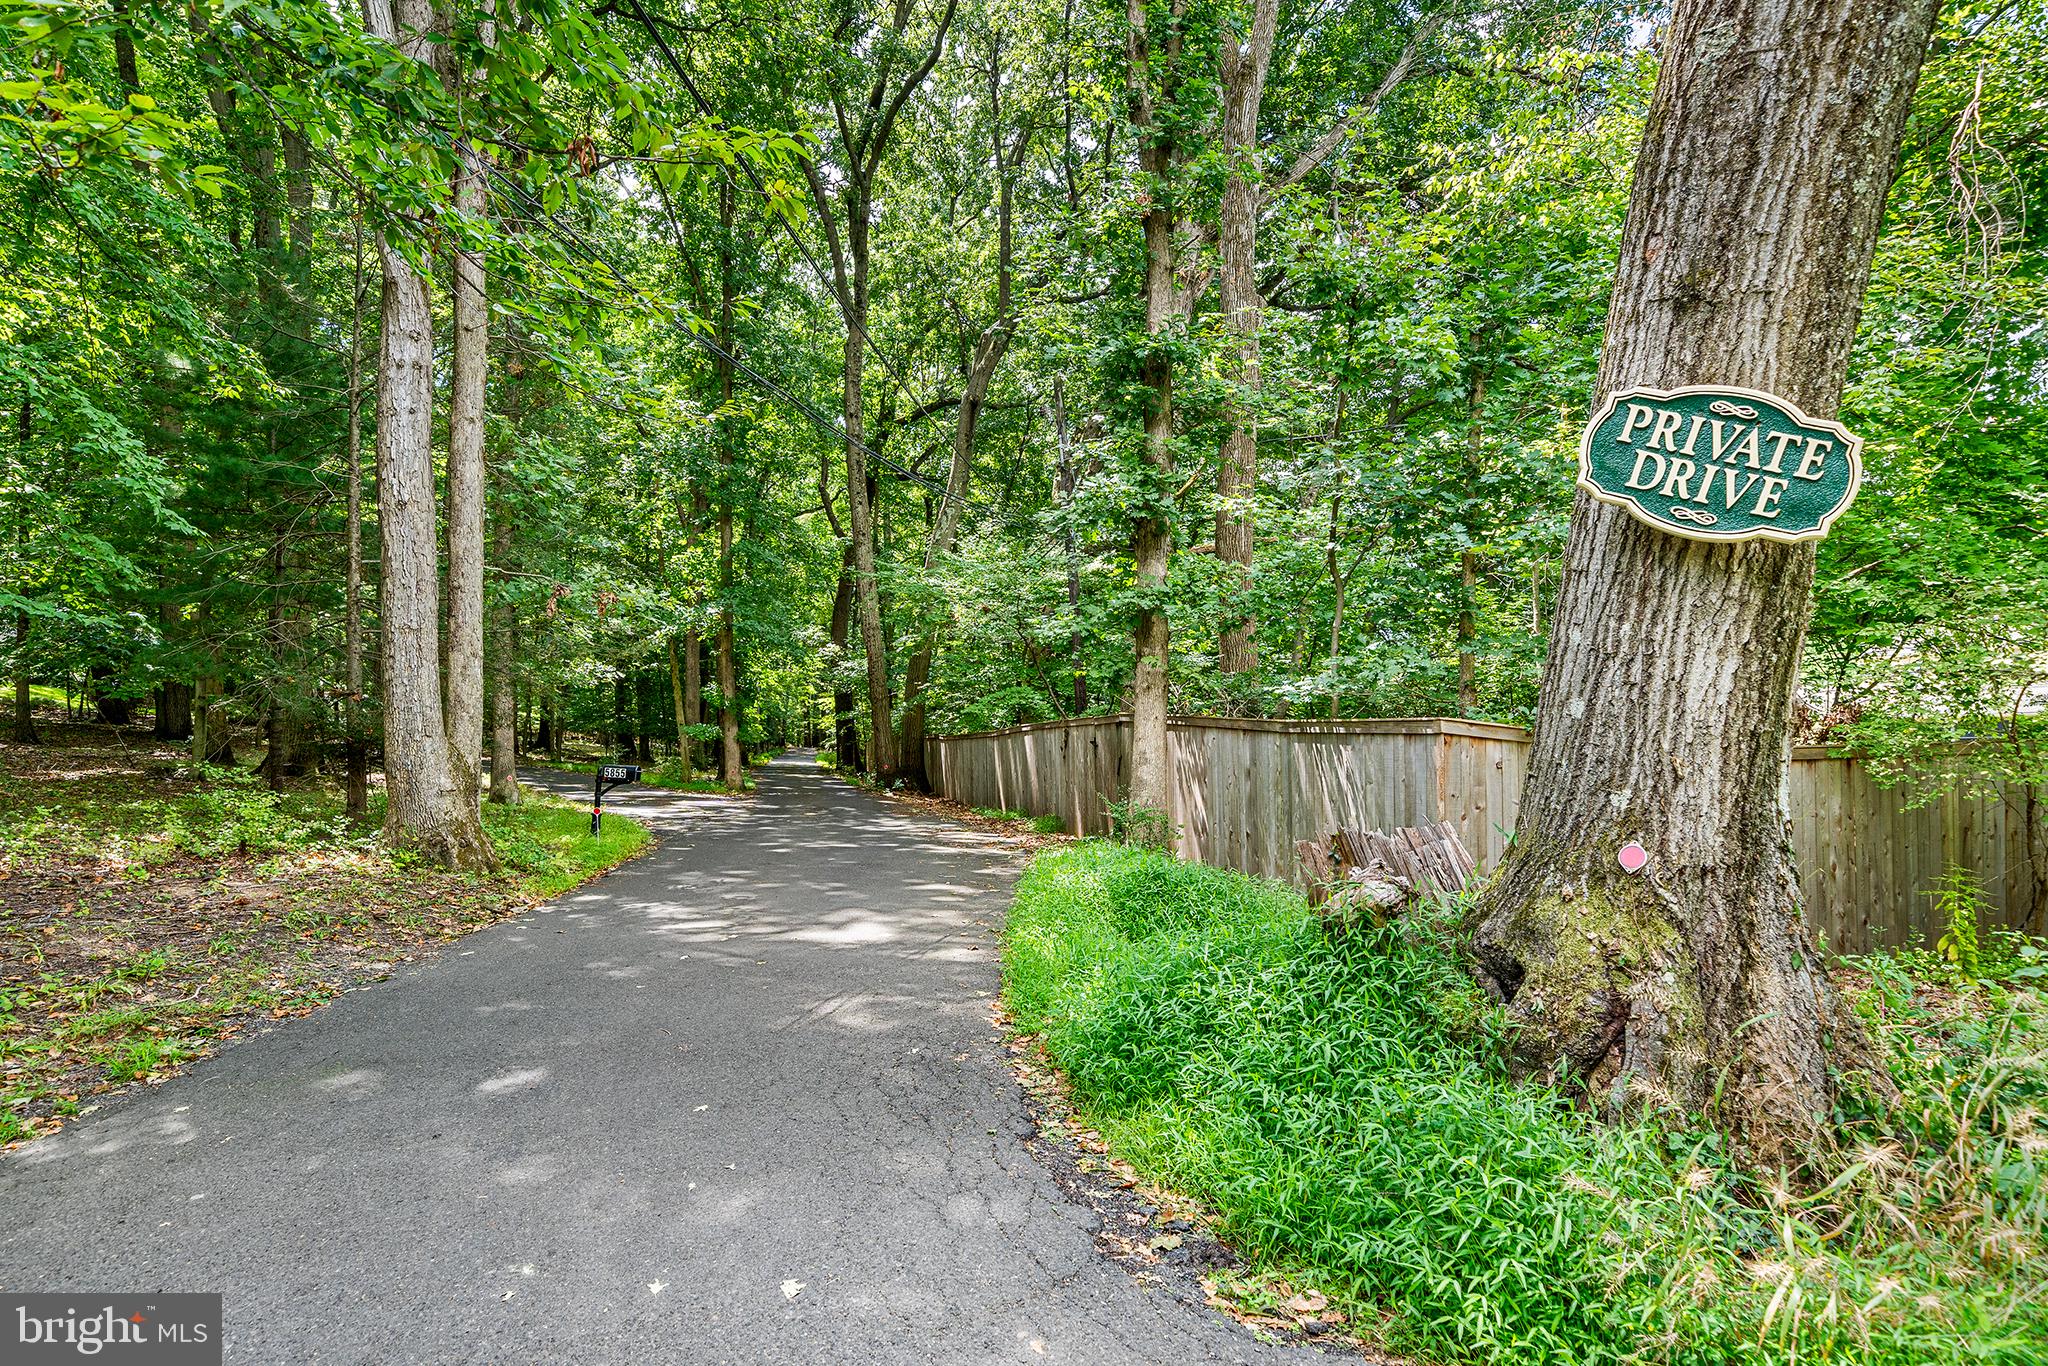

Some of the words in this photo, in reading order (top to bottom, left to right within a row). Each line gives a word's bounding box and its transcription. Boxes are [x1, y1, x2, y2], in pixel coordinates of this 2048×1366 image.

[1616, 403, 1832, 481] PRIVATE
[1624, 449, 1789, 519] DRIVE
[604, 767, 626, 778] 5855
